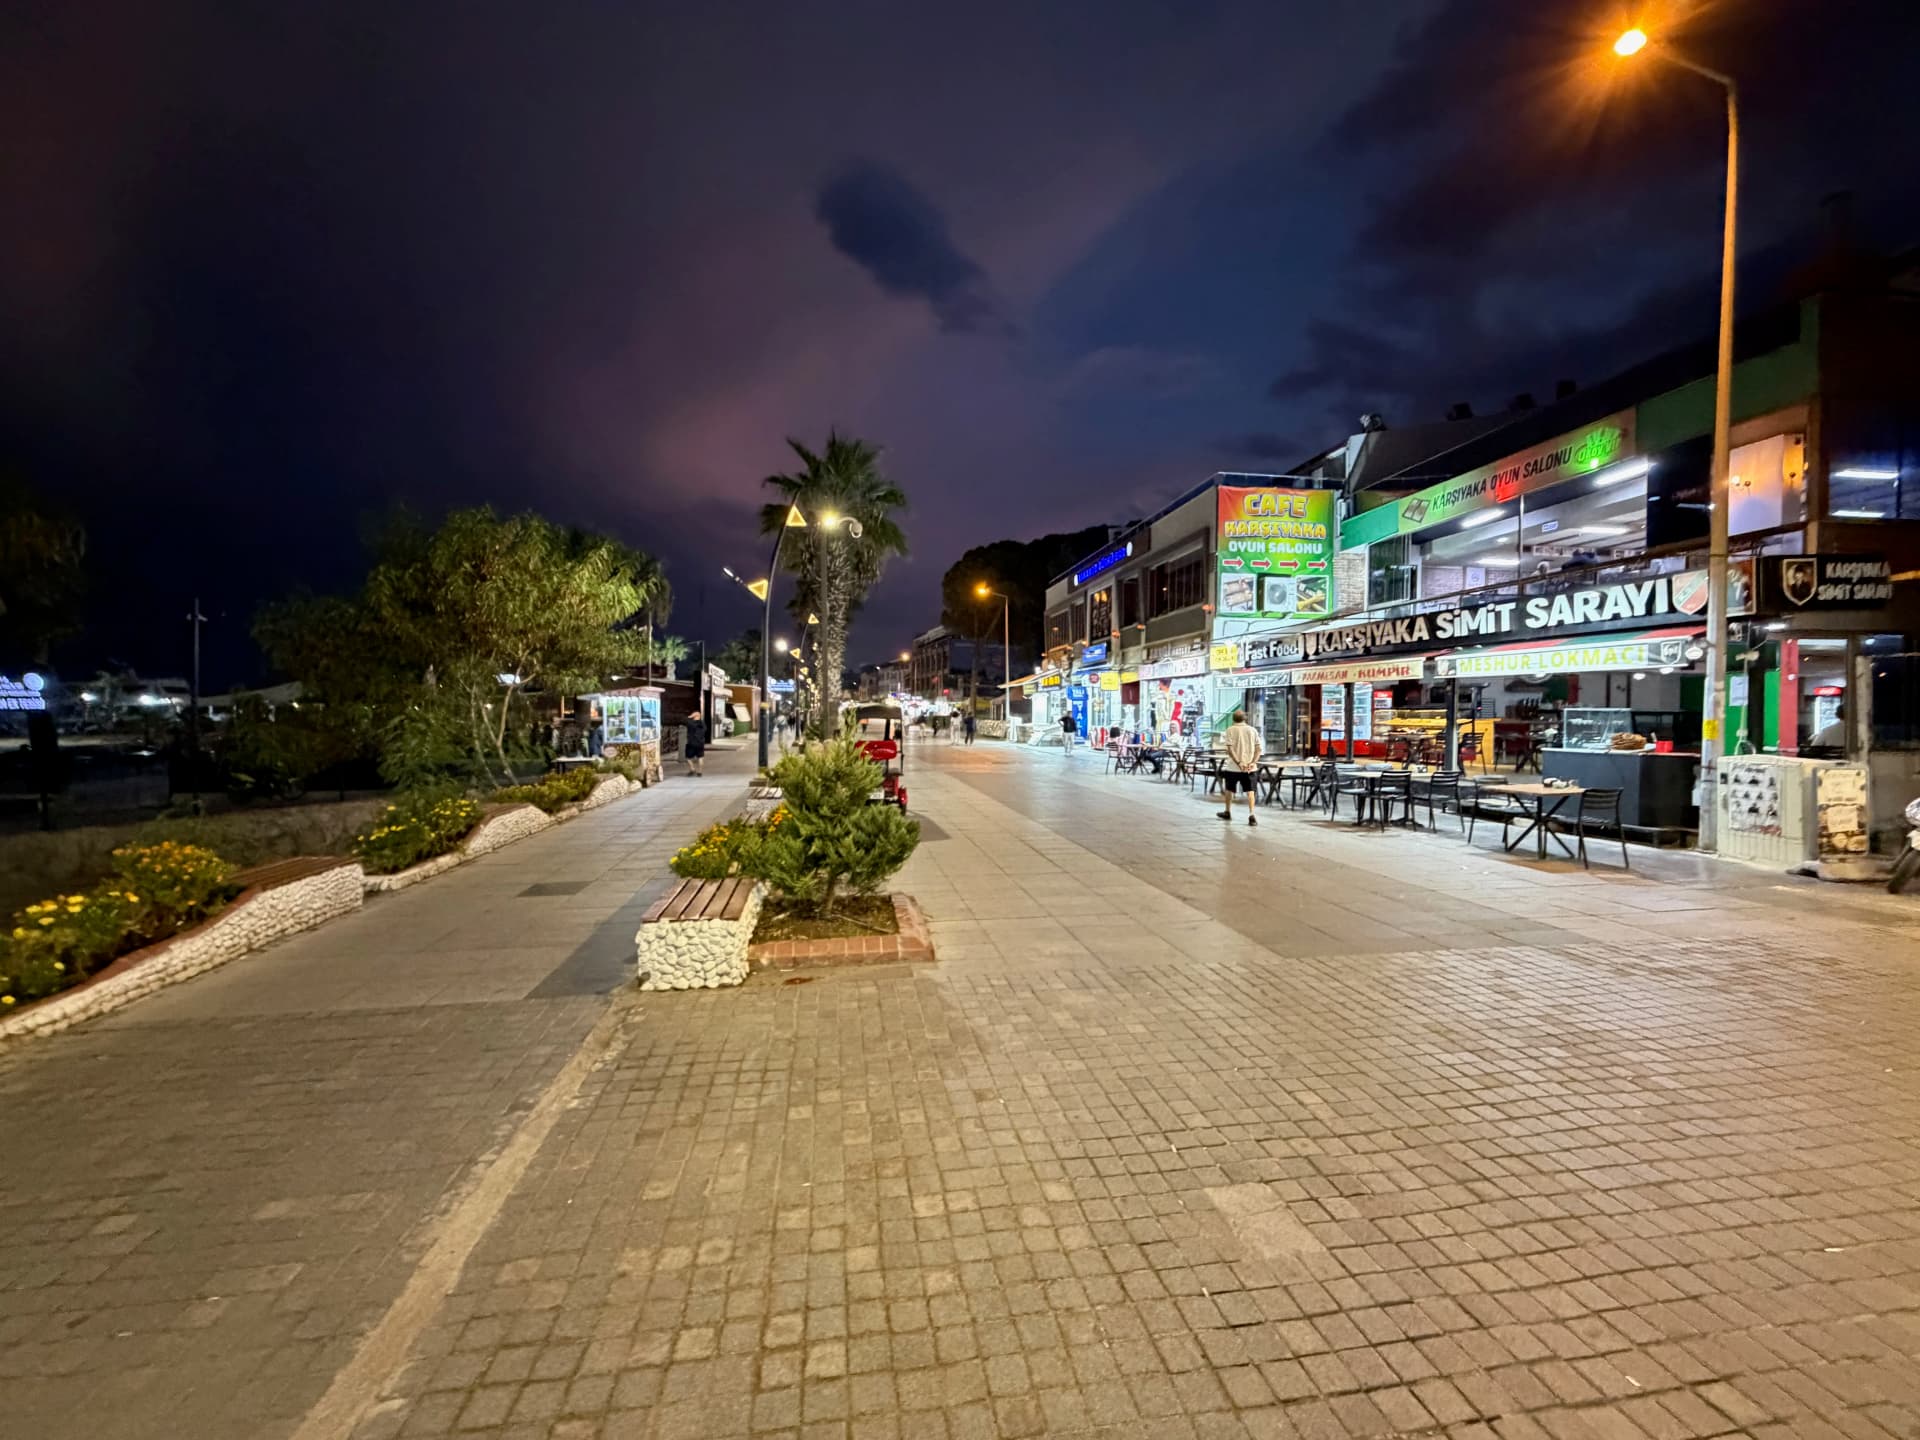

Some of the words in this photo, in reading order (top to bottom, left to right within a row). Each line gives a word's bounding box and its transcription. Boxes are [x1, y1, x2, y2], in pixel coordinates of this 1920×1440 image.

[1432, 478, 1487, 512] KARŞIYAKA
[1489, 466, 1521, 492] OYUN
[1522, 446, 1573, 478] SALONU
[1243, 493, 1308, 518] CAFE
[1224, 520, 1327, 540] KARŞIYAKA
[1228, 540, 1266, 553] OYUN
[1269, 542, 1323, 554] SALONU
[1318, 616, 1430, 655] KARŞIYAKA
[1525, 577, 1669, 629] SARAYI
[1245, 639, 1268, 661] Fast
[1270, 637, 1302, 658] Food
